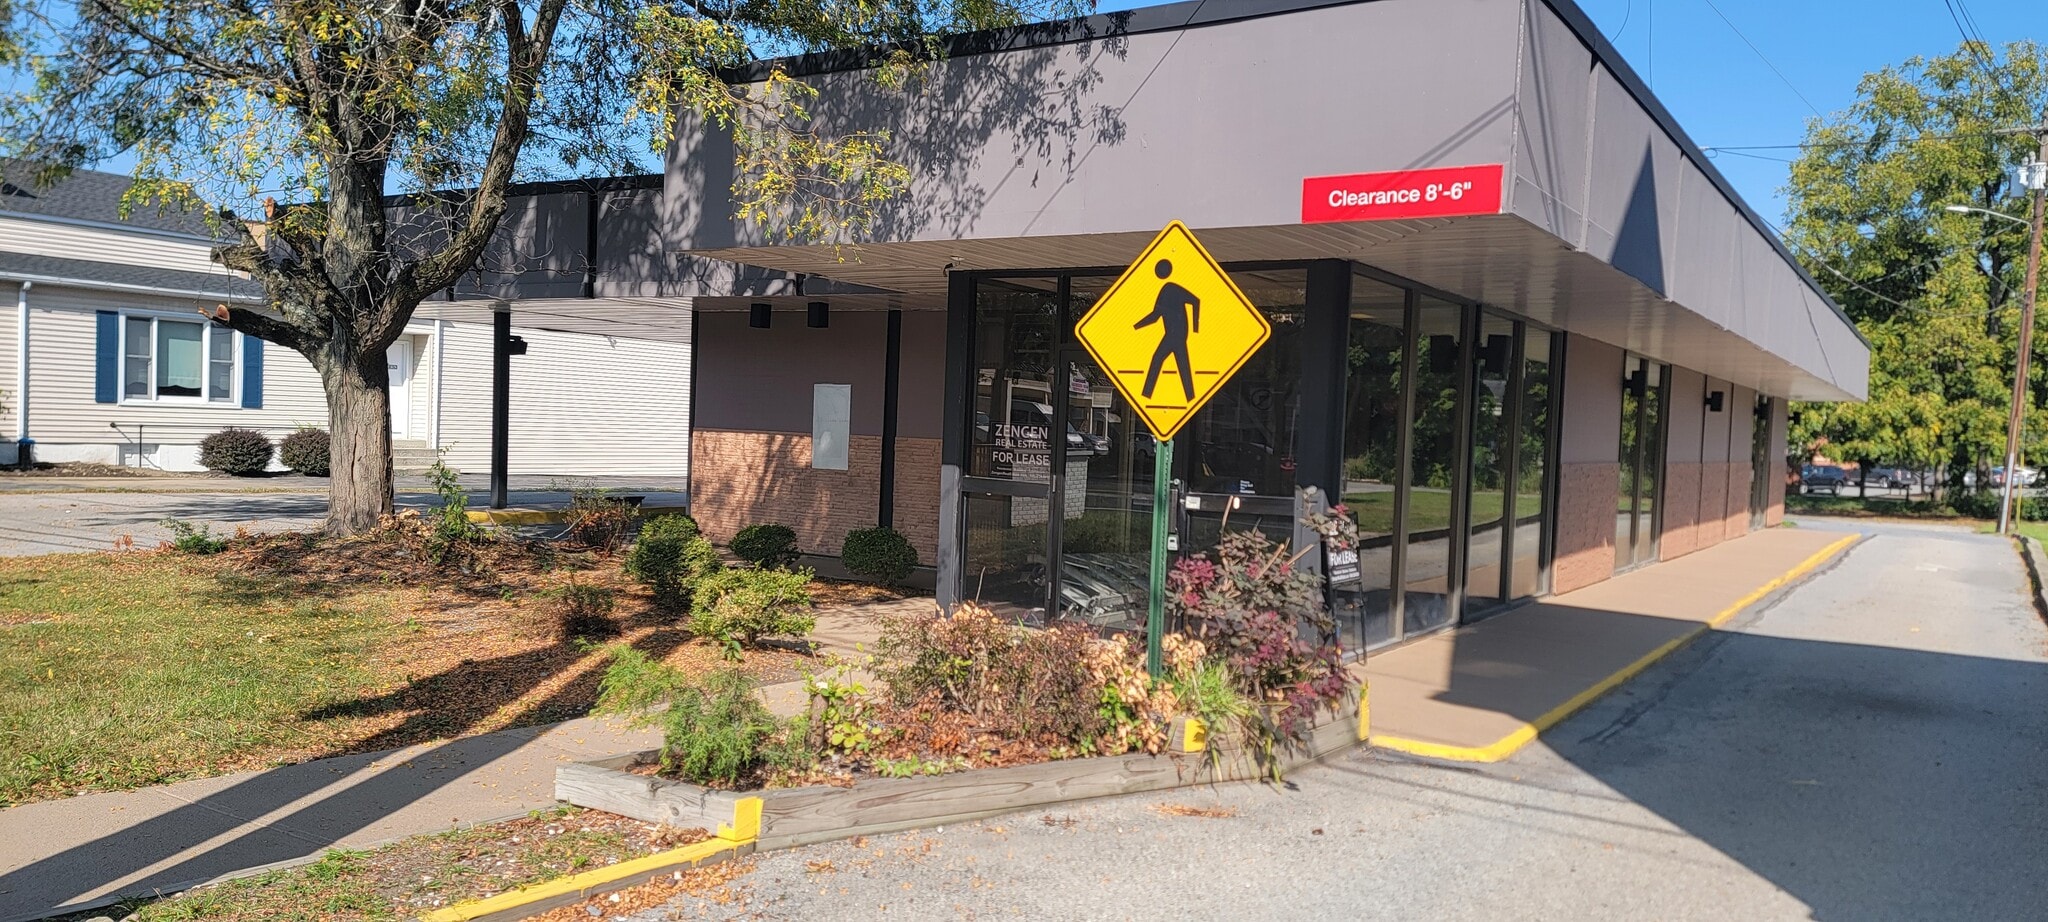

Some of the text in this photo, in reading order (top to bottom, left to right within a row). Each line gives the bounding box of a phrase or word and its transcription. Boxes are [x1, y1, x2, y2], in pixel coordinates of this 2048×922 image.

[1328, 181, 1472, 207] Clearance 8'-6"
[995, 424, 1048, 439] ZENGEN
[995, 439, 1047, 449] REAL ESTATE
[992, 452, 1049, 465] FOR LEASE
[1330, 552, 1342, 566] FOR
